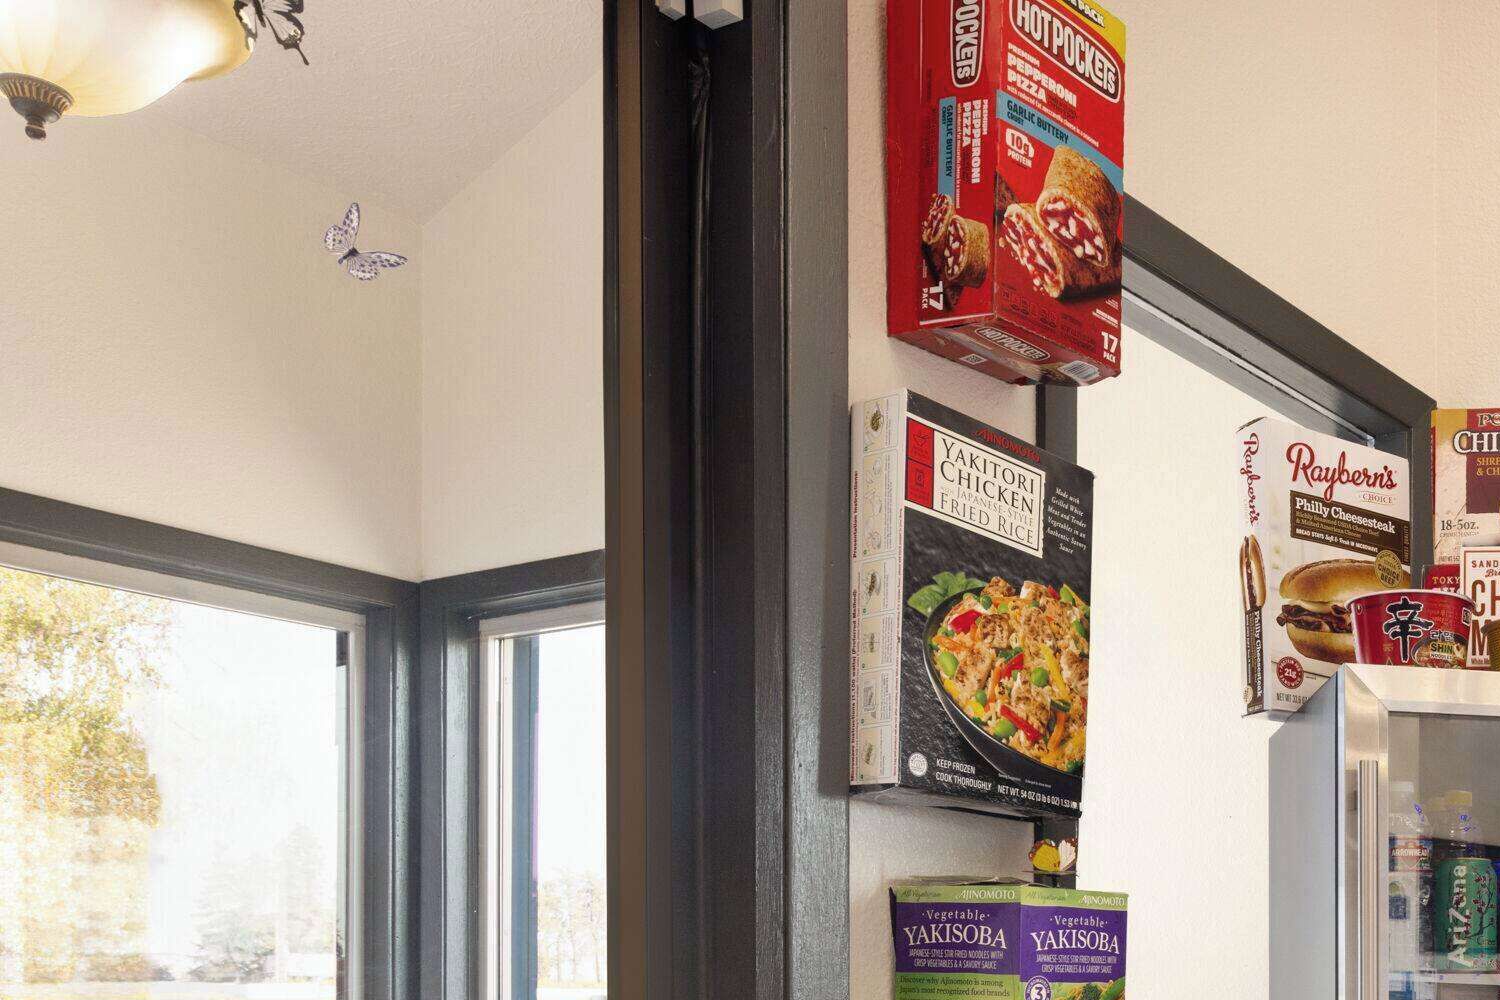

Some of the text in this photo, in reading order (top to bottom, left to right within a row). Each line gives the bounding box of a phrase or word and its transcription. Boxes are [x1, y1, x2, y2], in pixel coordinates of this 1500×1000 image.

[1008, 42, 1040, 67] PREMIUM
[1016, 1, 1116, 94] HOT POCKETS
[1007, 52, 1077, 108] PEPPERONI
[1007, 69, 1047, 103] PIZZA
[963, 102, 971, 147] PIZZA
[1007, 100, 1036, 124] GARLIC
[1037, 116, 1070, 144] BUTTERY
[972, 100, 982, 183] PEPPERONI
[1007, 150, 1032, 168] PROTEIN
[928, 281, 944, 311] 17
[1101, 331, 1118, 353] 17
[1103, 352, 1116, 363] PACK
[941, 438, 1034, 494] YAKITORI
[1286, 442, 1397, 502] Raybern's
[1476, 468, 1485, 477] &
[940, 459, 1034, 515] CHICKEN
[940, 491, 1034, 545] FRIED RICE
[1295, 497, 1396, 534] Philly Cheesesteak
[1432, 576, 1461, 584] TOKY
[1383, 596, 1435, 663] 辛
[1430, 642, 1454, 654] SHIN
[936, 758, 976, 775] KEEP FROZEN
[935, 771, 953, 783] COOK
[954, 774, 992, 790] THOROUGHLY
[1391, 848, 1430, 857] ARROWHEA
[955, 889, 1015, 901] AJINOMOTO
[1080, 893, 1125, 907] AJINOMOTO
[926, 909, 986, 921] Vegetable
[1054, 916, 1105, 928] Vegetable
[1447, 865, 1474, 967] AriZona
[903, 923, 1007, 949] YAKISOBA
[1030, 929, 1120, 954] YAKISOBA
